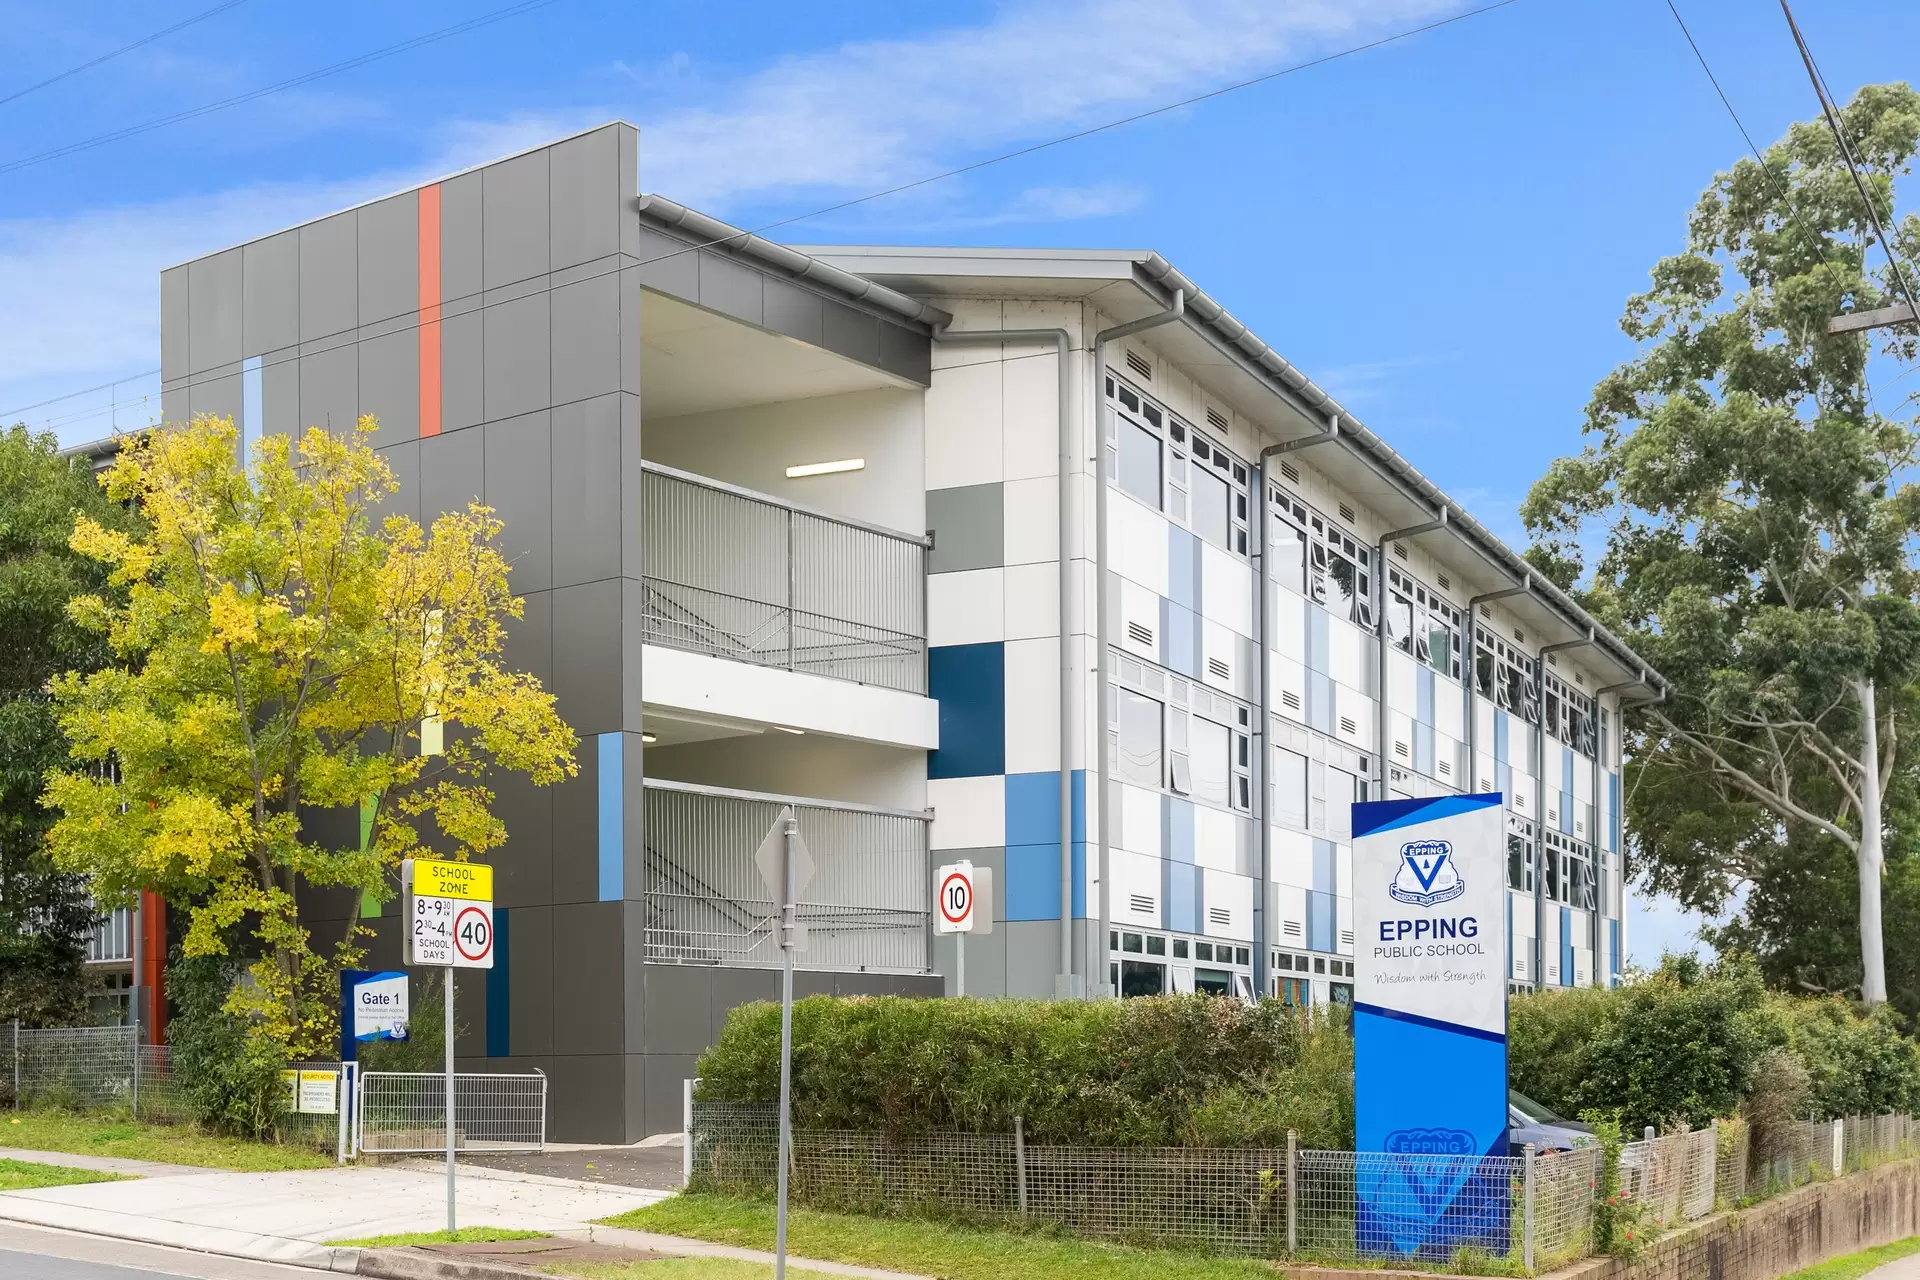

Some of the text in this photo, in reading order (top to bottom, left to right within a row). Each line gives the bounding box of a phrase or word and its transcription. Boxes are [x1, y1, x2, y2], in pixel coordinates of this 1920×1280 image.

[1409, 847, 1444, 856] EPPING
[432, 866, 475, 880] SCHOOL
[439, 882, 468, 894] ZONE
[949, 886, 965, 910] 10
[461, 922, 486, 945] 40
[1379, 917, 1478, 941] EPPING
[419, 939, 450, 948] SCHOOL
[423, 950, 445, 959] DAYS
[1374, 943, 1485, 958] PUBLIC SCHOOL
[1374, 969, 1487, 985] Wisdom with Strength
[362, 992, 399, 1005] Gate 1
[1401, 1141, 1460, 1153] EPPING
